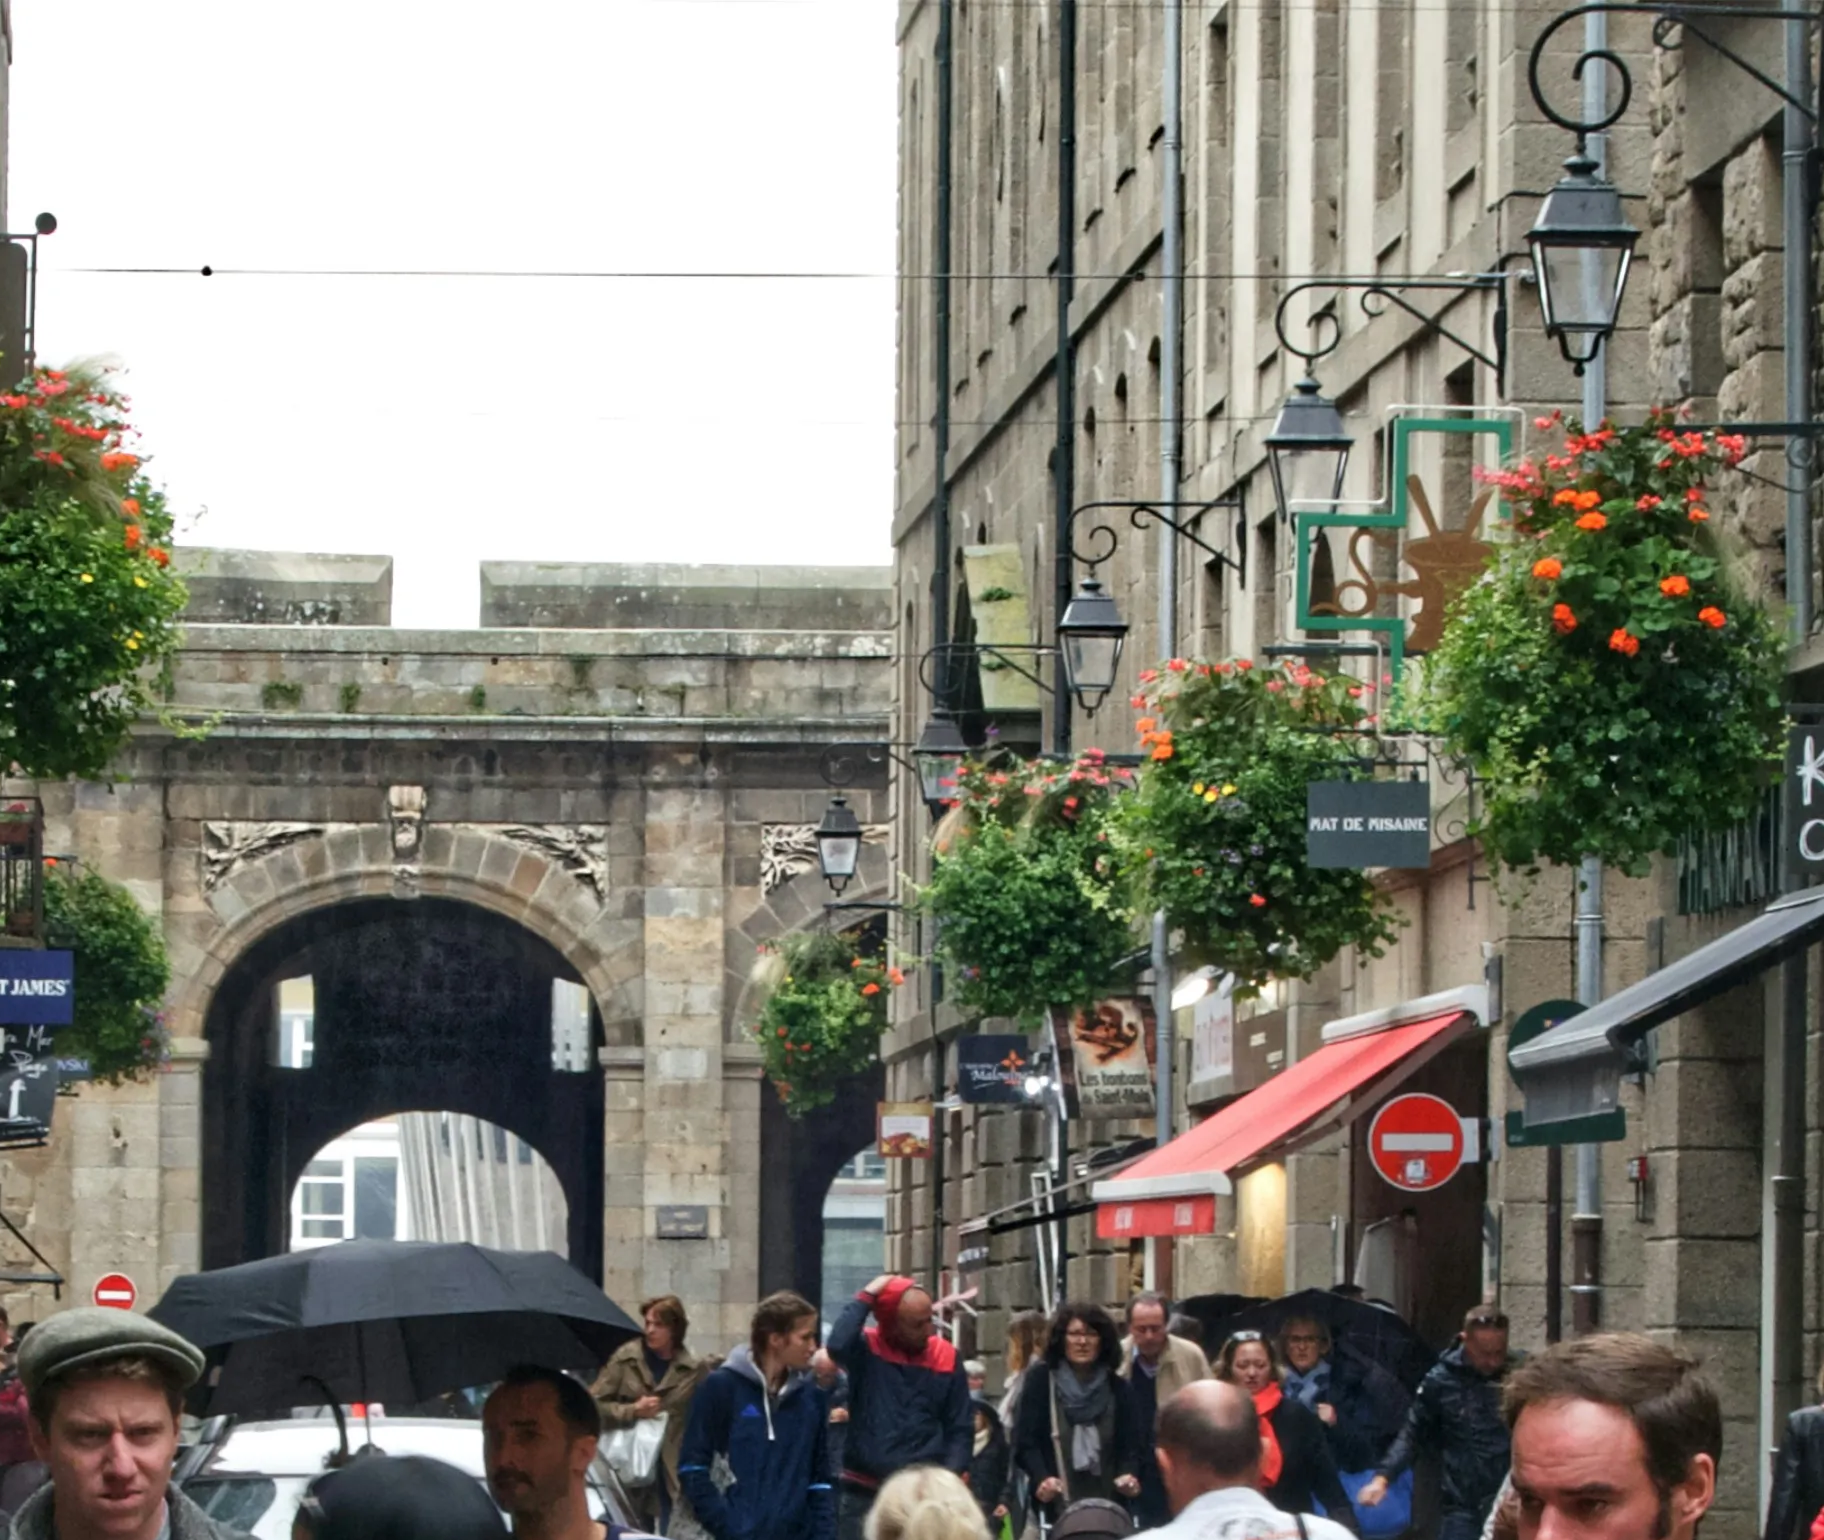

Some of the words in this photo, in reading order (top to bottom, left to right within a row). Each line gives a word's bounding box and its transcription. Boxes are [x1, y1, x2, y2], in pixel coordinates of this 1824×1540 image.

[1309, 817, 1339, 832] MAT
[1342, 817, 1365, 832] DE
[1367, 817, 1428, 832] MISAINE
[10, 978, 67, 997] JAMES
